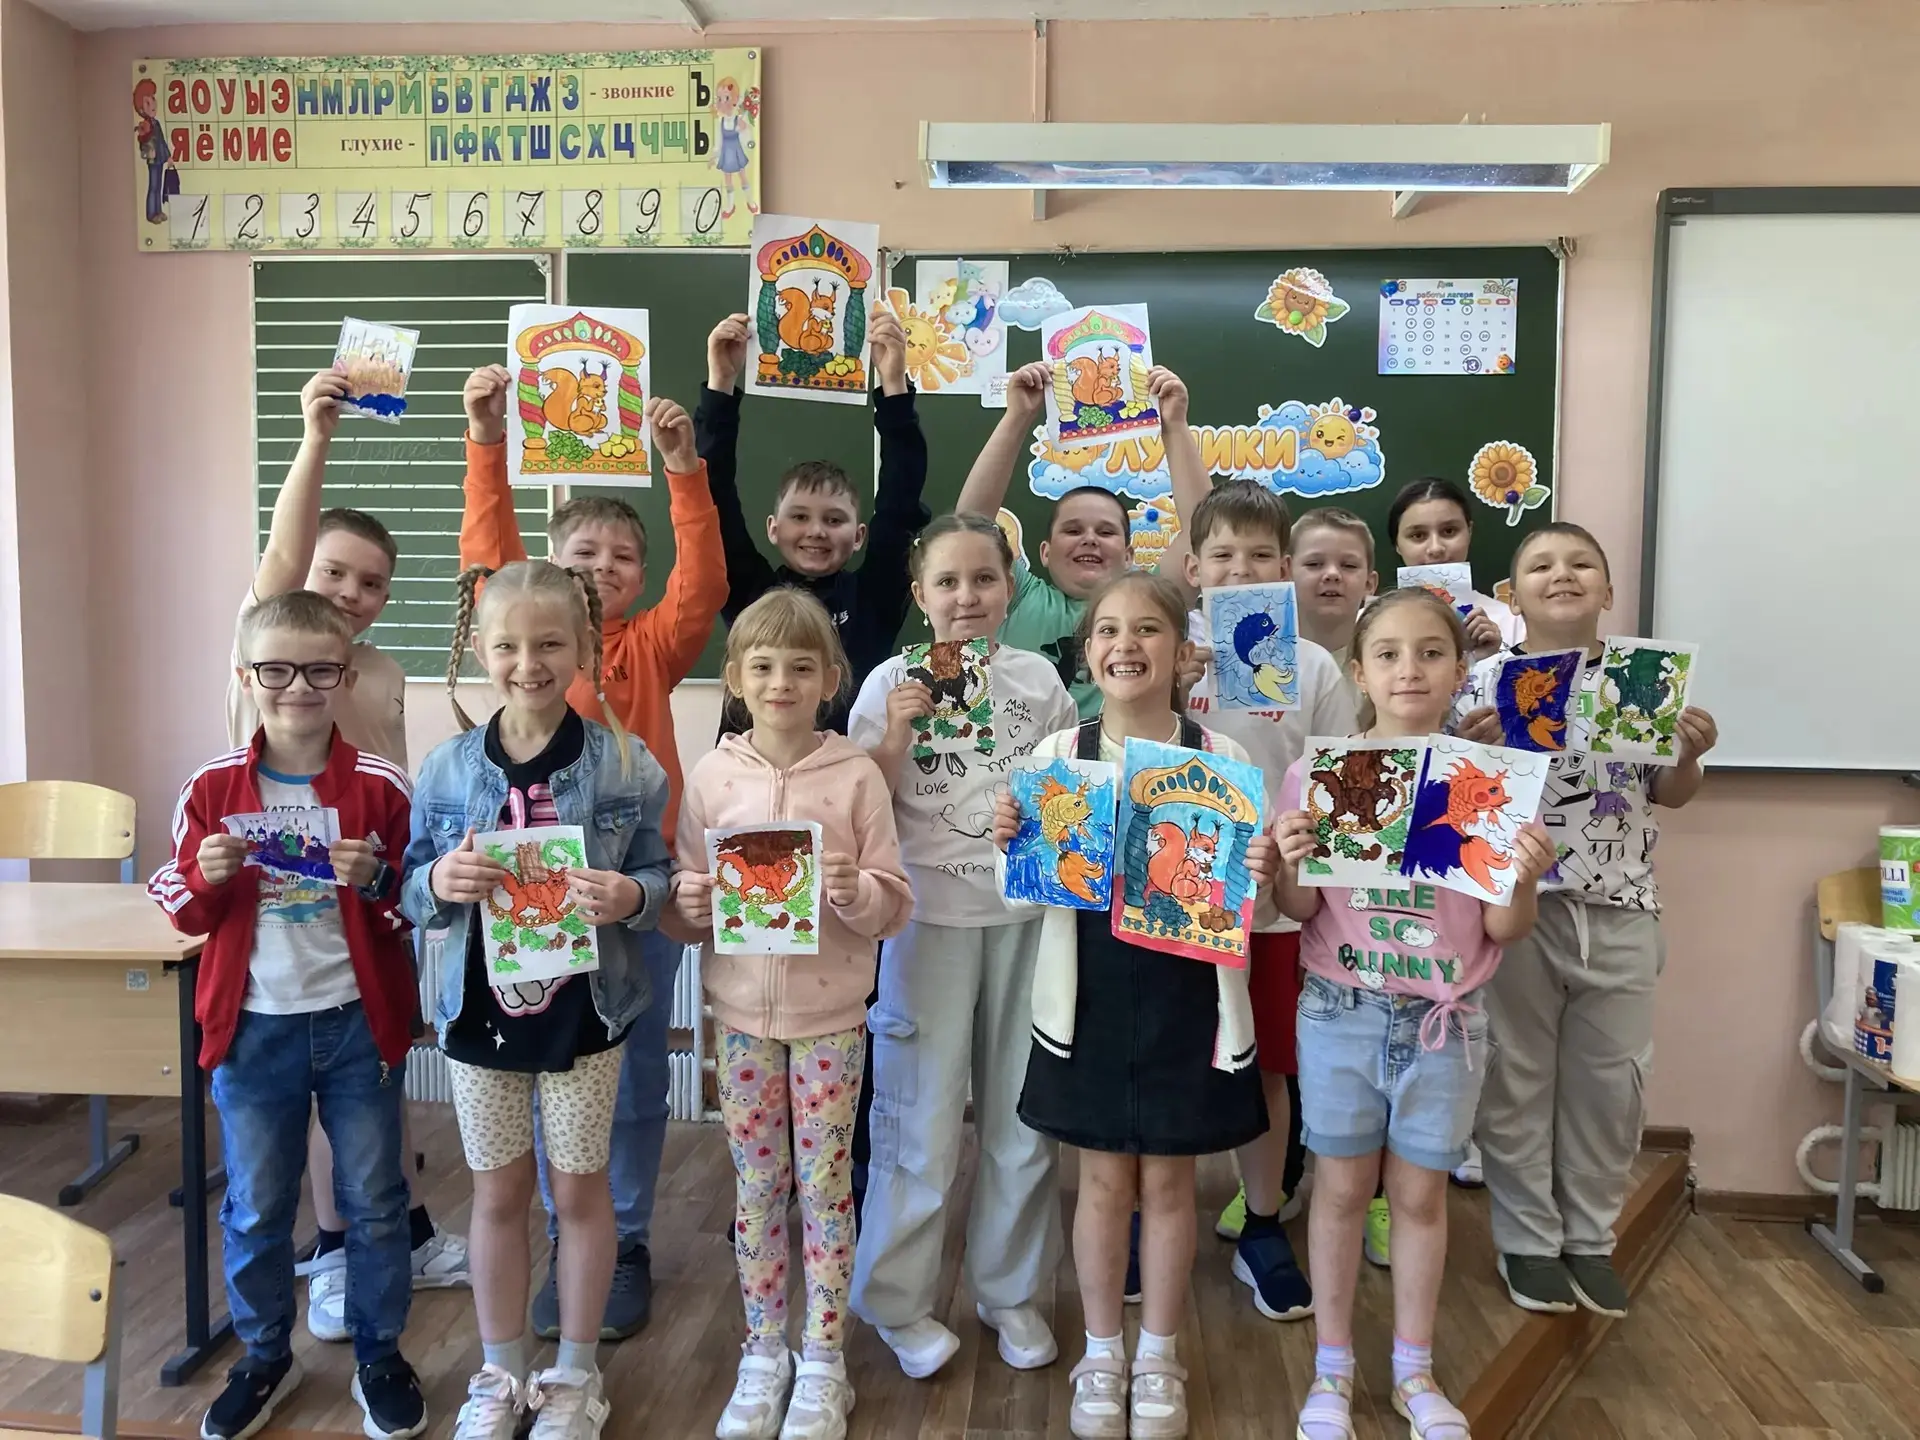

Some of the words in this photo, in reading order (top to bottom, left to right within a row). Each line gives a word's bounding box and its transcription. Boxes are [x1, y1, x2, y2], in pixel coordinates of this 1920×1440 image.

[601, 85, 675, 100] звонкие
[341, 138, 403, 156] глухие
[192, 194, 208, 239] 1
[237, 194, 264, 239] 2
[296, 193, 319, 238] 3
[351, 192, 375, 238] 4
[400, 193, 432, 238] 5
[463, 192, 488, 237] 6
[516, 191, 544, 236] 7
[578, 190, 603, 235] 8
[635, 188, 661, 234] 9
[695, 188, 722, 233] 0
[1416, 291, 1445, 299] работы
[1483, 284, 1511, 296] 2026
[1106, 429, 1296, 474] ЛУИКИ
[1133, 531, 1170, 548] МЫ
[1338, 943, 1456, 983] BUNNY
